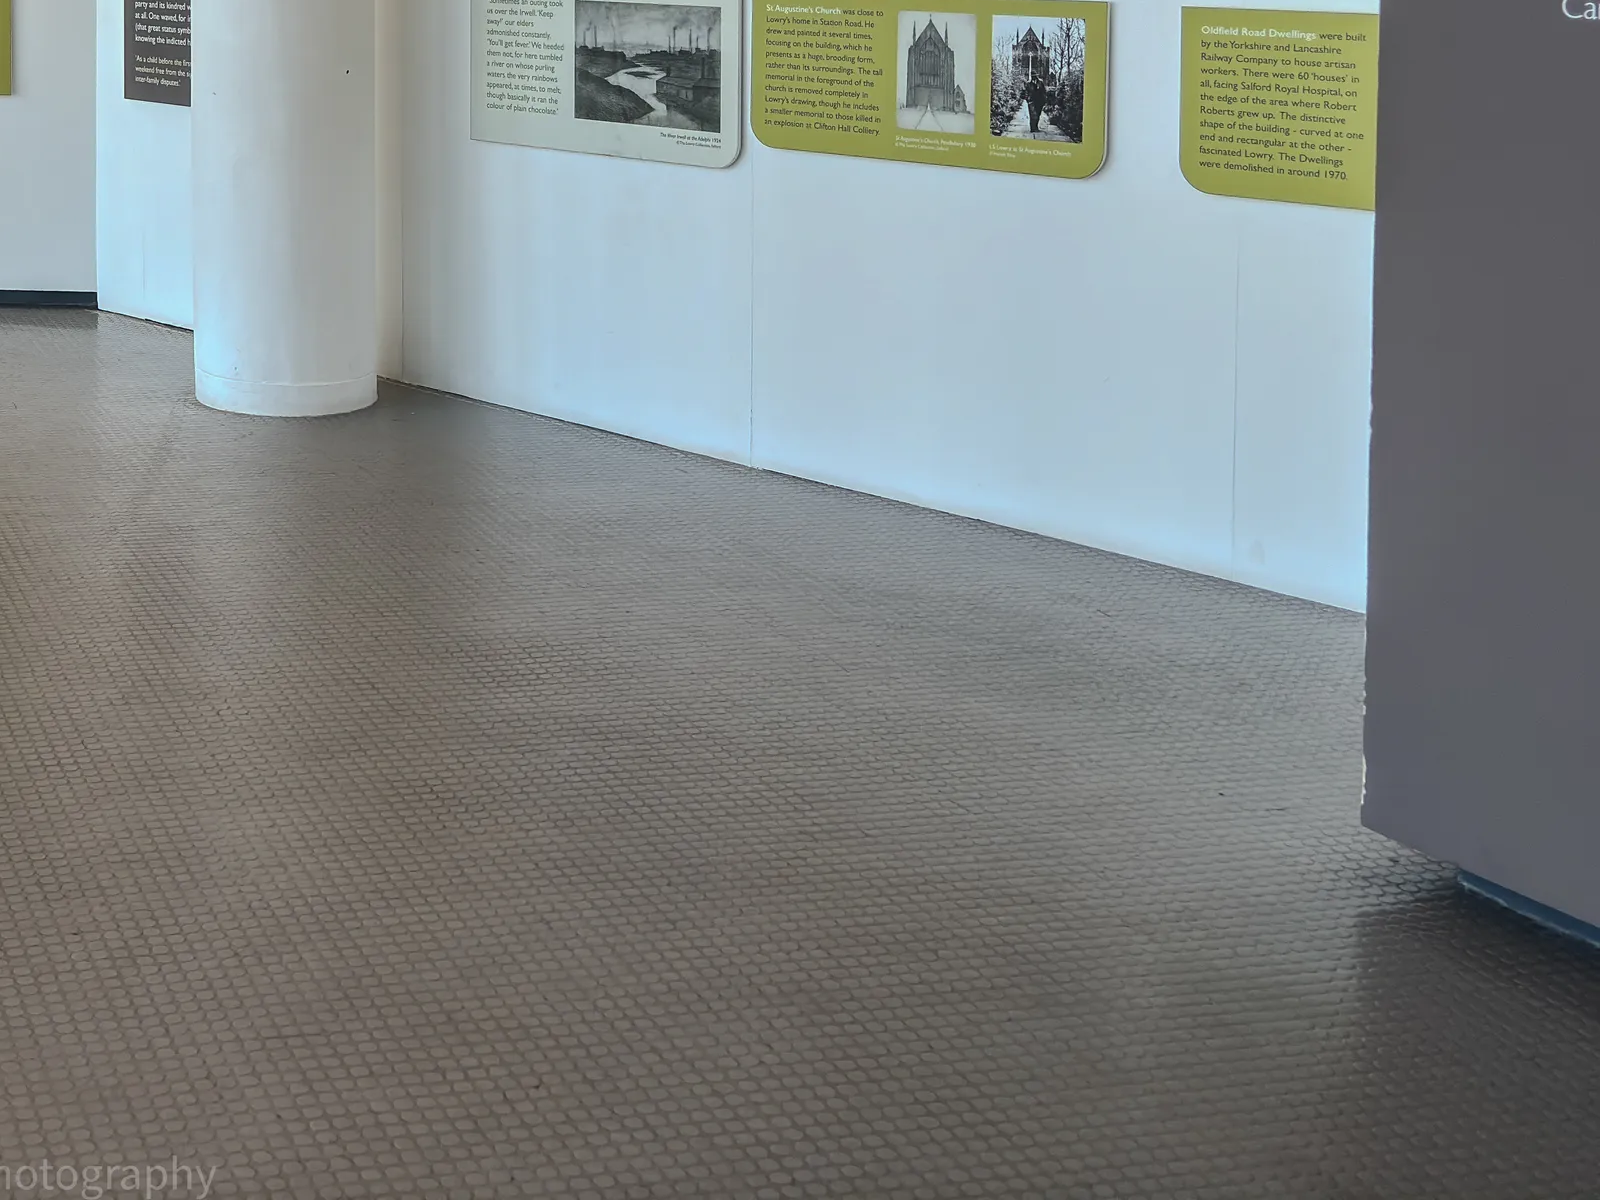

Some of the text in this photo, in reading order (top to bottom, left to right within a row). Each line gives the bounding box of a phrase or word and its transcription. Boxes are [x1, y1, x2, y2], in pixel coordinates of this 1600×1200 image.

[1200, 25, 1317, 42] Oldfield Road Dwellings
